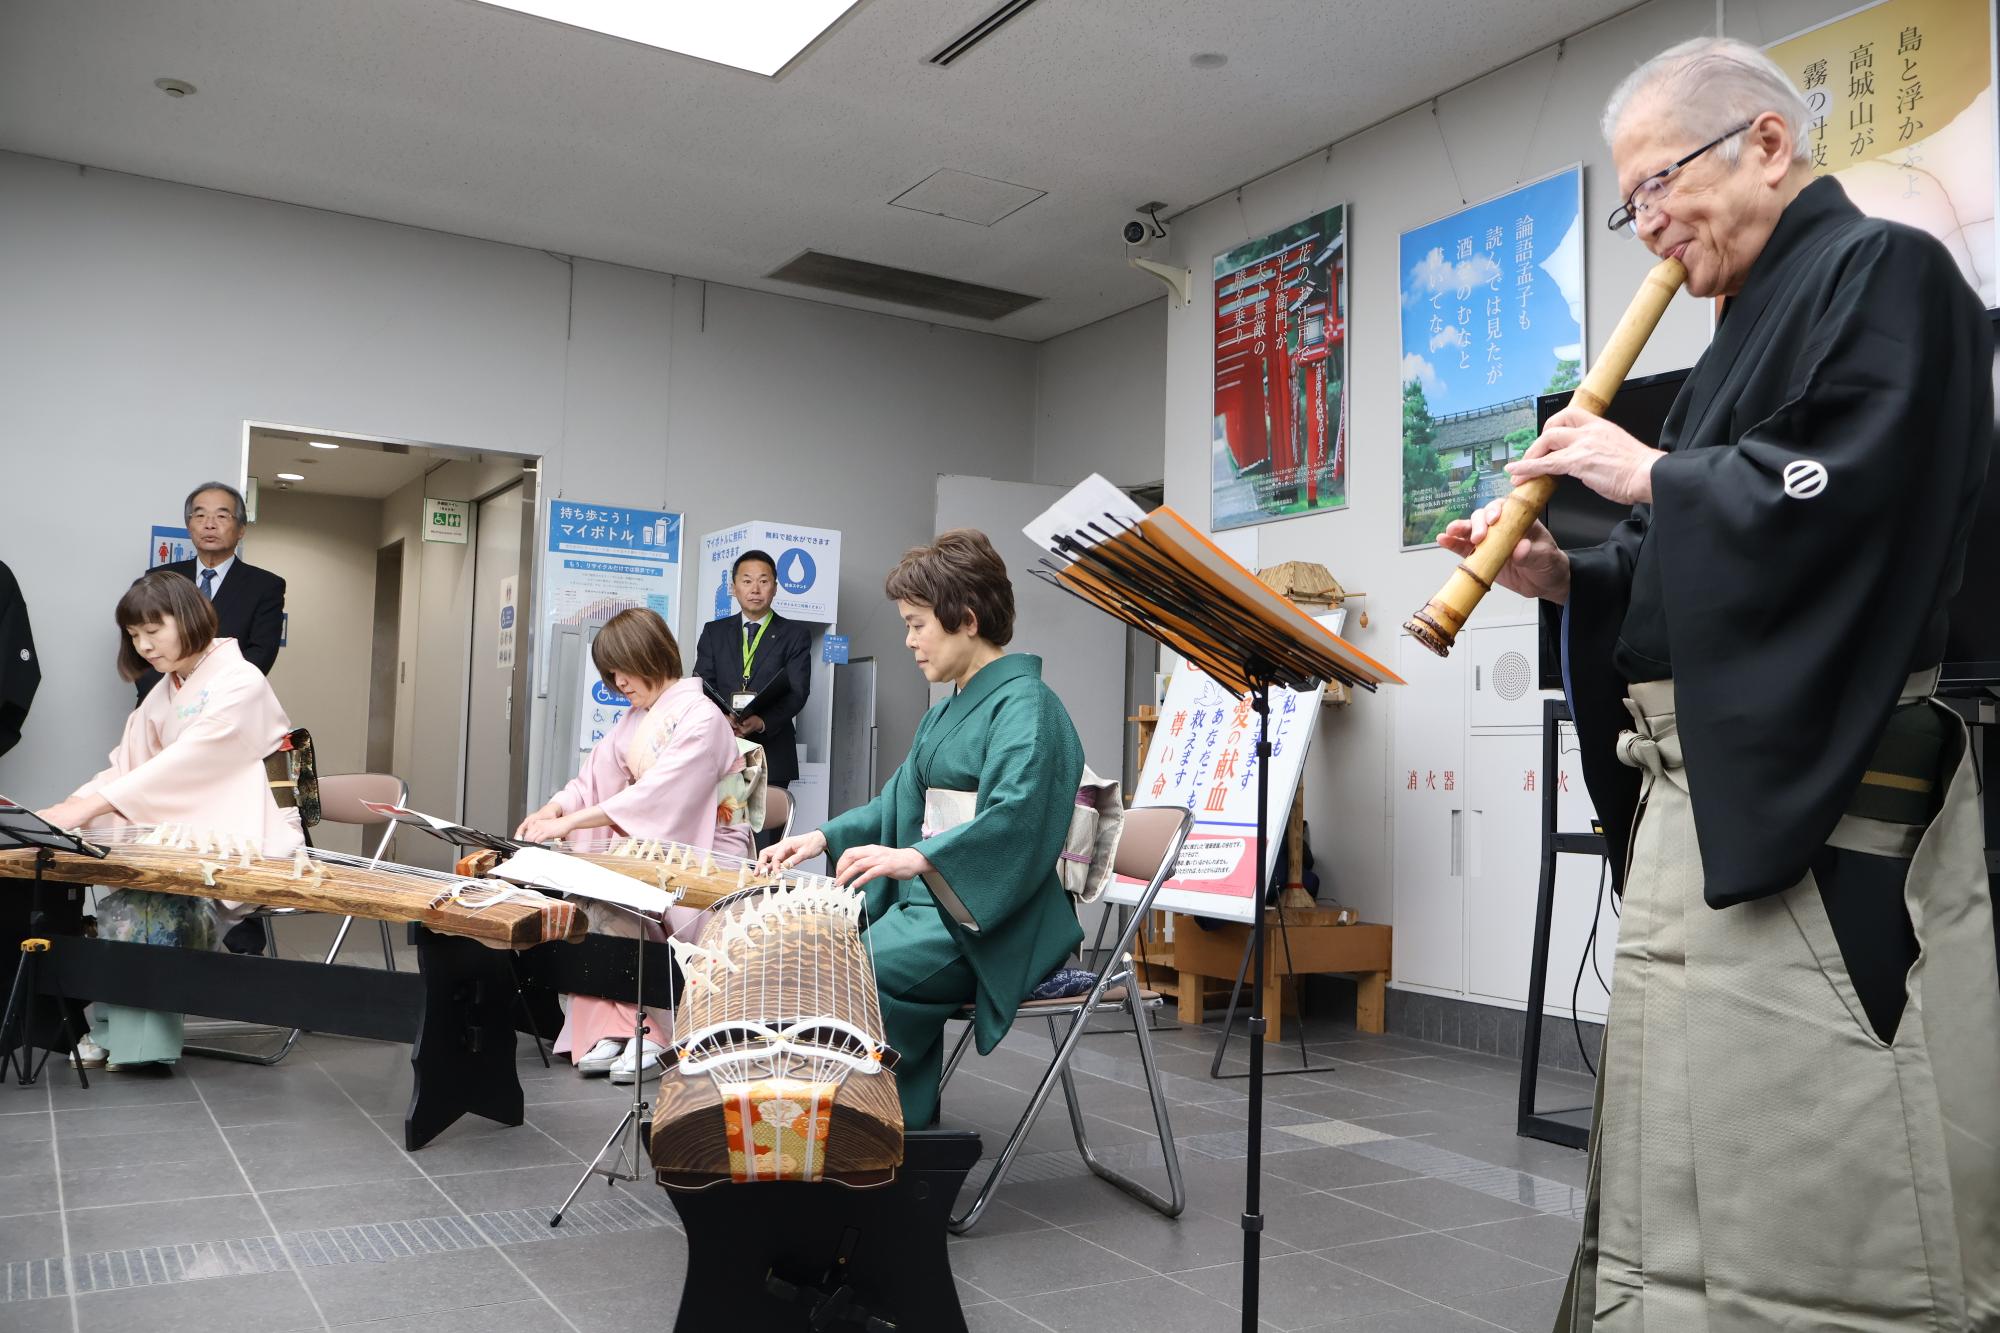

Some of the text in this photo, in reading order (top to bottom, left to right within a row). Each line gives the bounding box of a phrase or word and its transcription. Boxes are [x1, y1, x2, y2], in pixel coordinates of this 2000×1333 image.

[1803, 59, 1828, 174] 霧の丹波
[1848, 42, 1874, 157] 高城山が
[1254, 261, 1267, 355] 天下無敵の
[1275, 252, 1288, 350] 平左衛門が
[1485, 226, 1503, 385] 読んでは見たが
[1515, 214, 1534, 330] 論語孟子も
[561, 524, 635, 541] マイボトル
[712, 547, 740, 562] 給水できます
[766, 531, 830, 545] 無料で給水ができます
[1152, 710, 1188, 798] 尊い命
[1175, 710, 1206, 788] 救えます
[1187, 708, 1224, 809] あなたにも
[1204, 697, 1252, 811] 愛の献血
[1273, 695, 1296, 757] 私にも
[1407, 770, 1455, 791] 消火器
